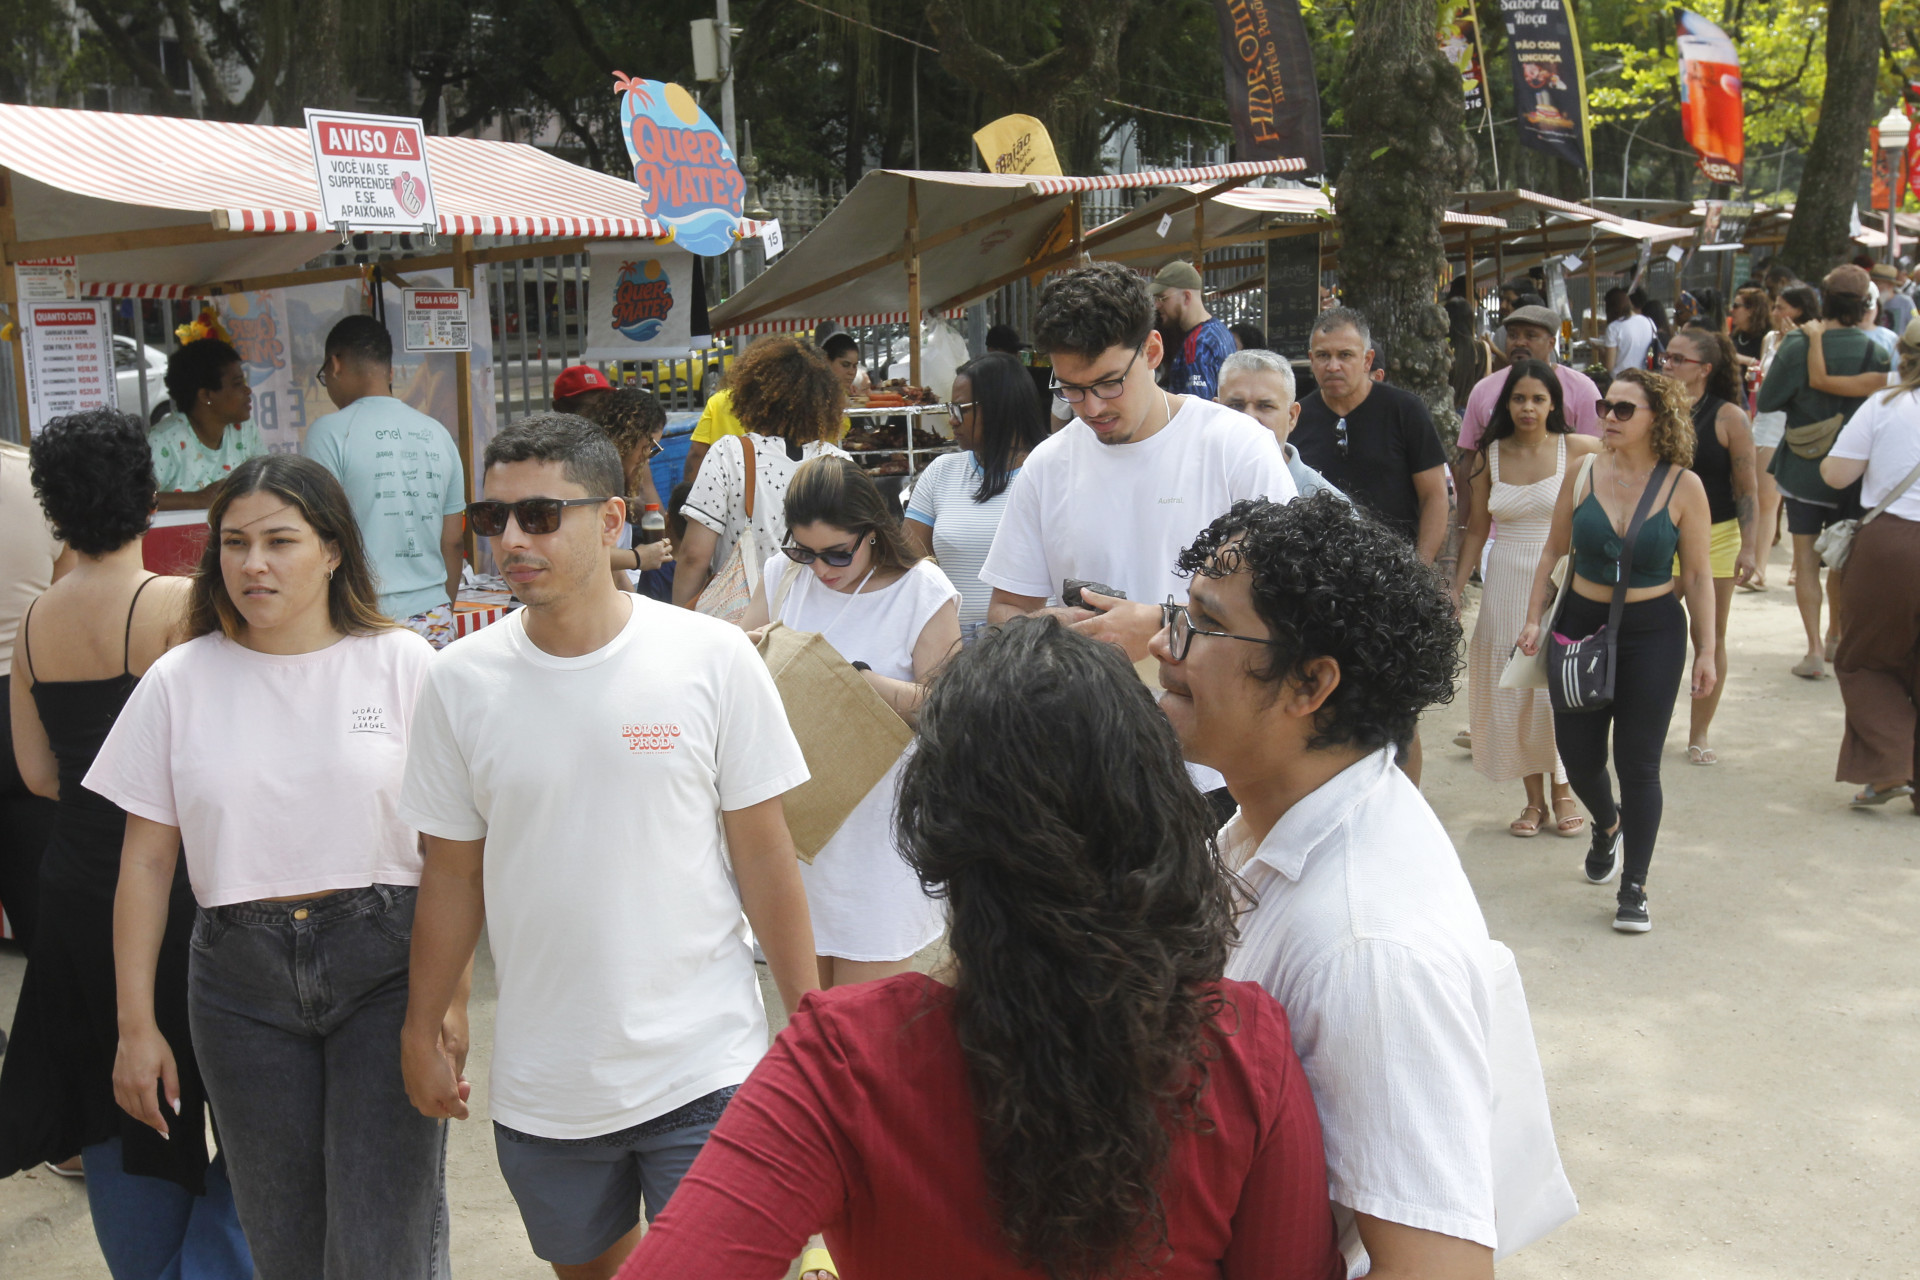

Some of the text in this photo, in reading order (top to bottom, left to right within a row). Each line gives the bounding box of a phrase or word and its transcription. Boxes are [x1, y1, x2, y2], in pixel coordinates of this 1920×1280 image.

[1501, 0, 1560, 11] Sabor da
[1250, 0, 1272, 38] Pagã
[1514, 11, 1548, 28] Roça
[1515, 39, 1561, 50] PÃO COM
[1518, 53, 1562, 65] LINGUIÇA
[1227, 0, 1280, 144] HIDROM
[328, 126, 388, 154] AVISO
[330, 158, 390, 176] VOCÊ VAI SE
[328, 175, 397, 190] SURPREENDER
[635, 162, 745, 216] MATE?
[355, 191, 376, 204] E SE
[341, 204, 396, 219] APAIXONAR
[767, 233, 779, 248] 15
[415, 295, 458, 304] PEGA A VISÃO
[36, 311, 93, 322] QUANTO CUSTA:
[611, 297, 673, 330] MATE?
[375, 428, 402, 440] enel
[402, 490, 420, 498] TAG
[352, 706, 383, 715] WORLD
[353, 722, 387, 730] LEAGUE
[621, 723, 681, 738] BOLOVO
[629, 737, 675, 750] PROD.
